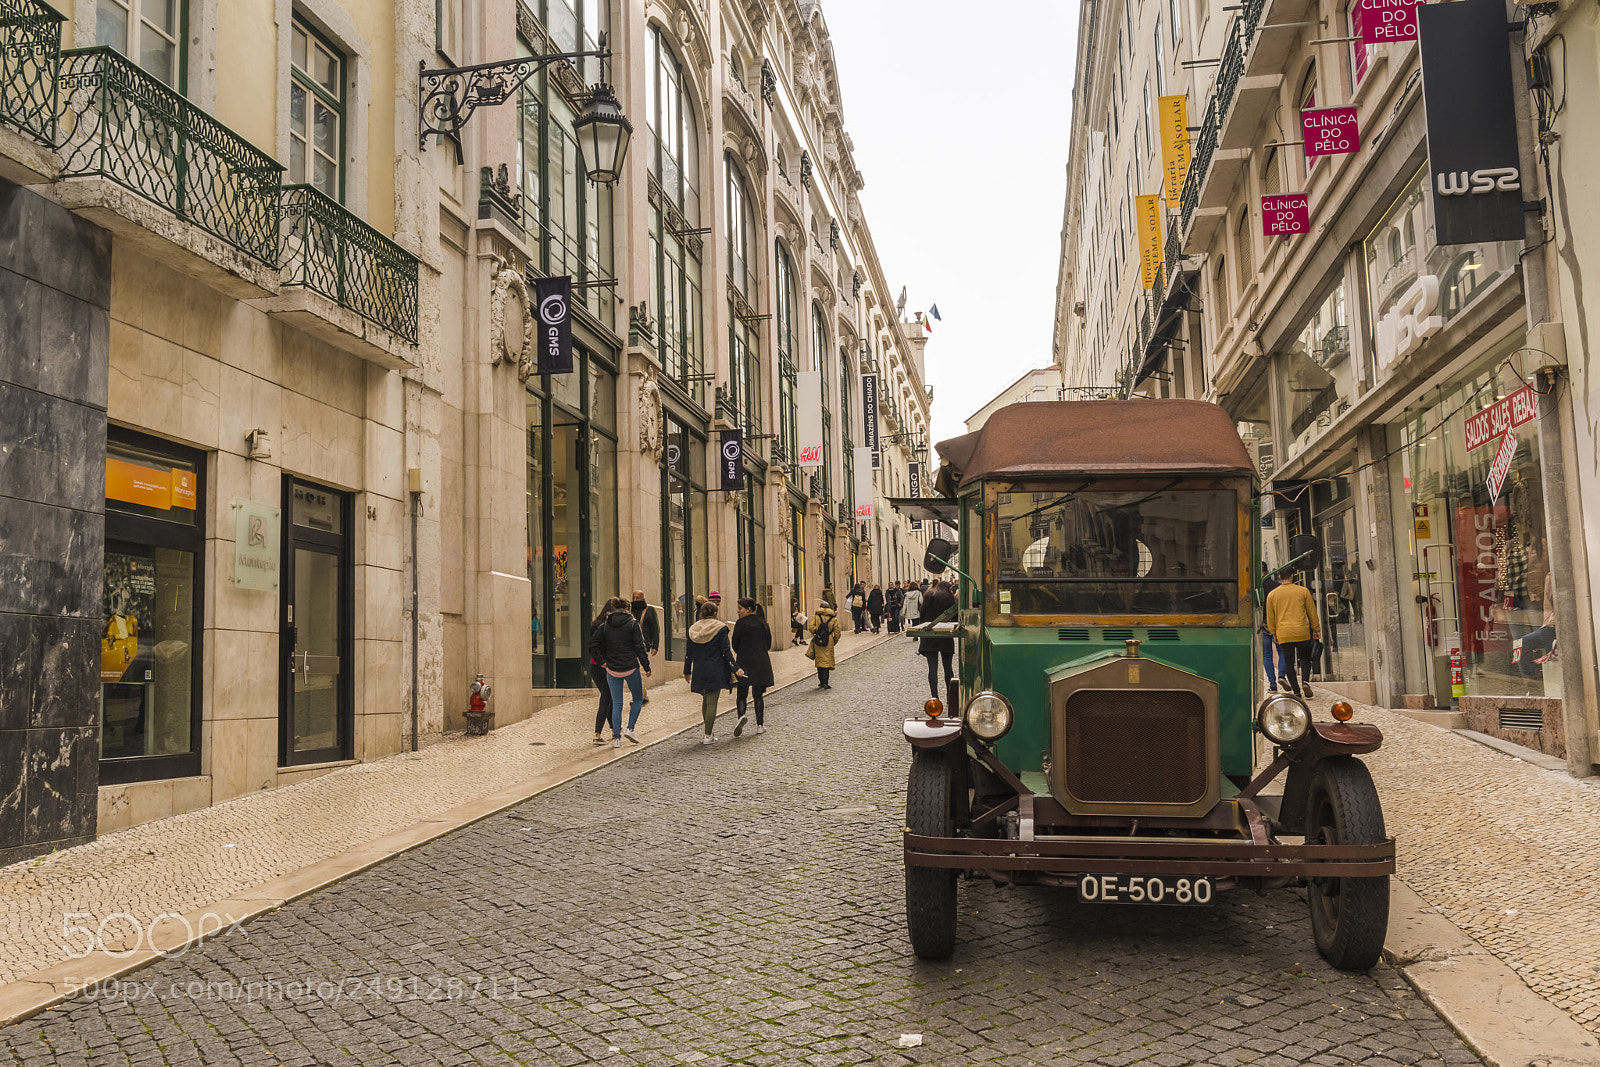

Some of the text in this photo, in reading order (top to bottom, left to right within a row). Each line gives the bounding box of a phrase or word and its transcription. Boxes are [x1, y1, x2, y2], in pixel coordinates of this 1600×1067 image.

[1382, 9, 1407, 23] DO
[1374, 23, 1416, 38] PÊLO
[1173, 100, 1184, 139] SOLAR
[1303, 114, 1357, 128] CLÍNICA
[1321, 127, 1342, 139] DO
[1314, 139, 1350, 152] PÊLO
[1167, 160, 1178, 201] livraria
[1262, 200, 1308, 211] CLÍNICA
[1148, 199, 1157, 231] SOLAR
[1276, 211, 1294, 221] DO
[1271, 220, 1301, 232] PÊLO
[1144, 249, 1153, 283] livraria
[548, 327, 560, 356] GMS
[867, 405, 874, 414] DO
[1466, 412, 1490, 449] SALDOS
[1491, 400, 1512, 436] SALES
[800, 446, 821, 462] H&M
[728, 461, 736, 480] GMS
[367, 505, 377, 521] 54
[856, 504, 873, 517] H&M
[1474, 513, 1499, 623] SALDOS
